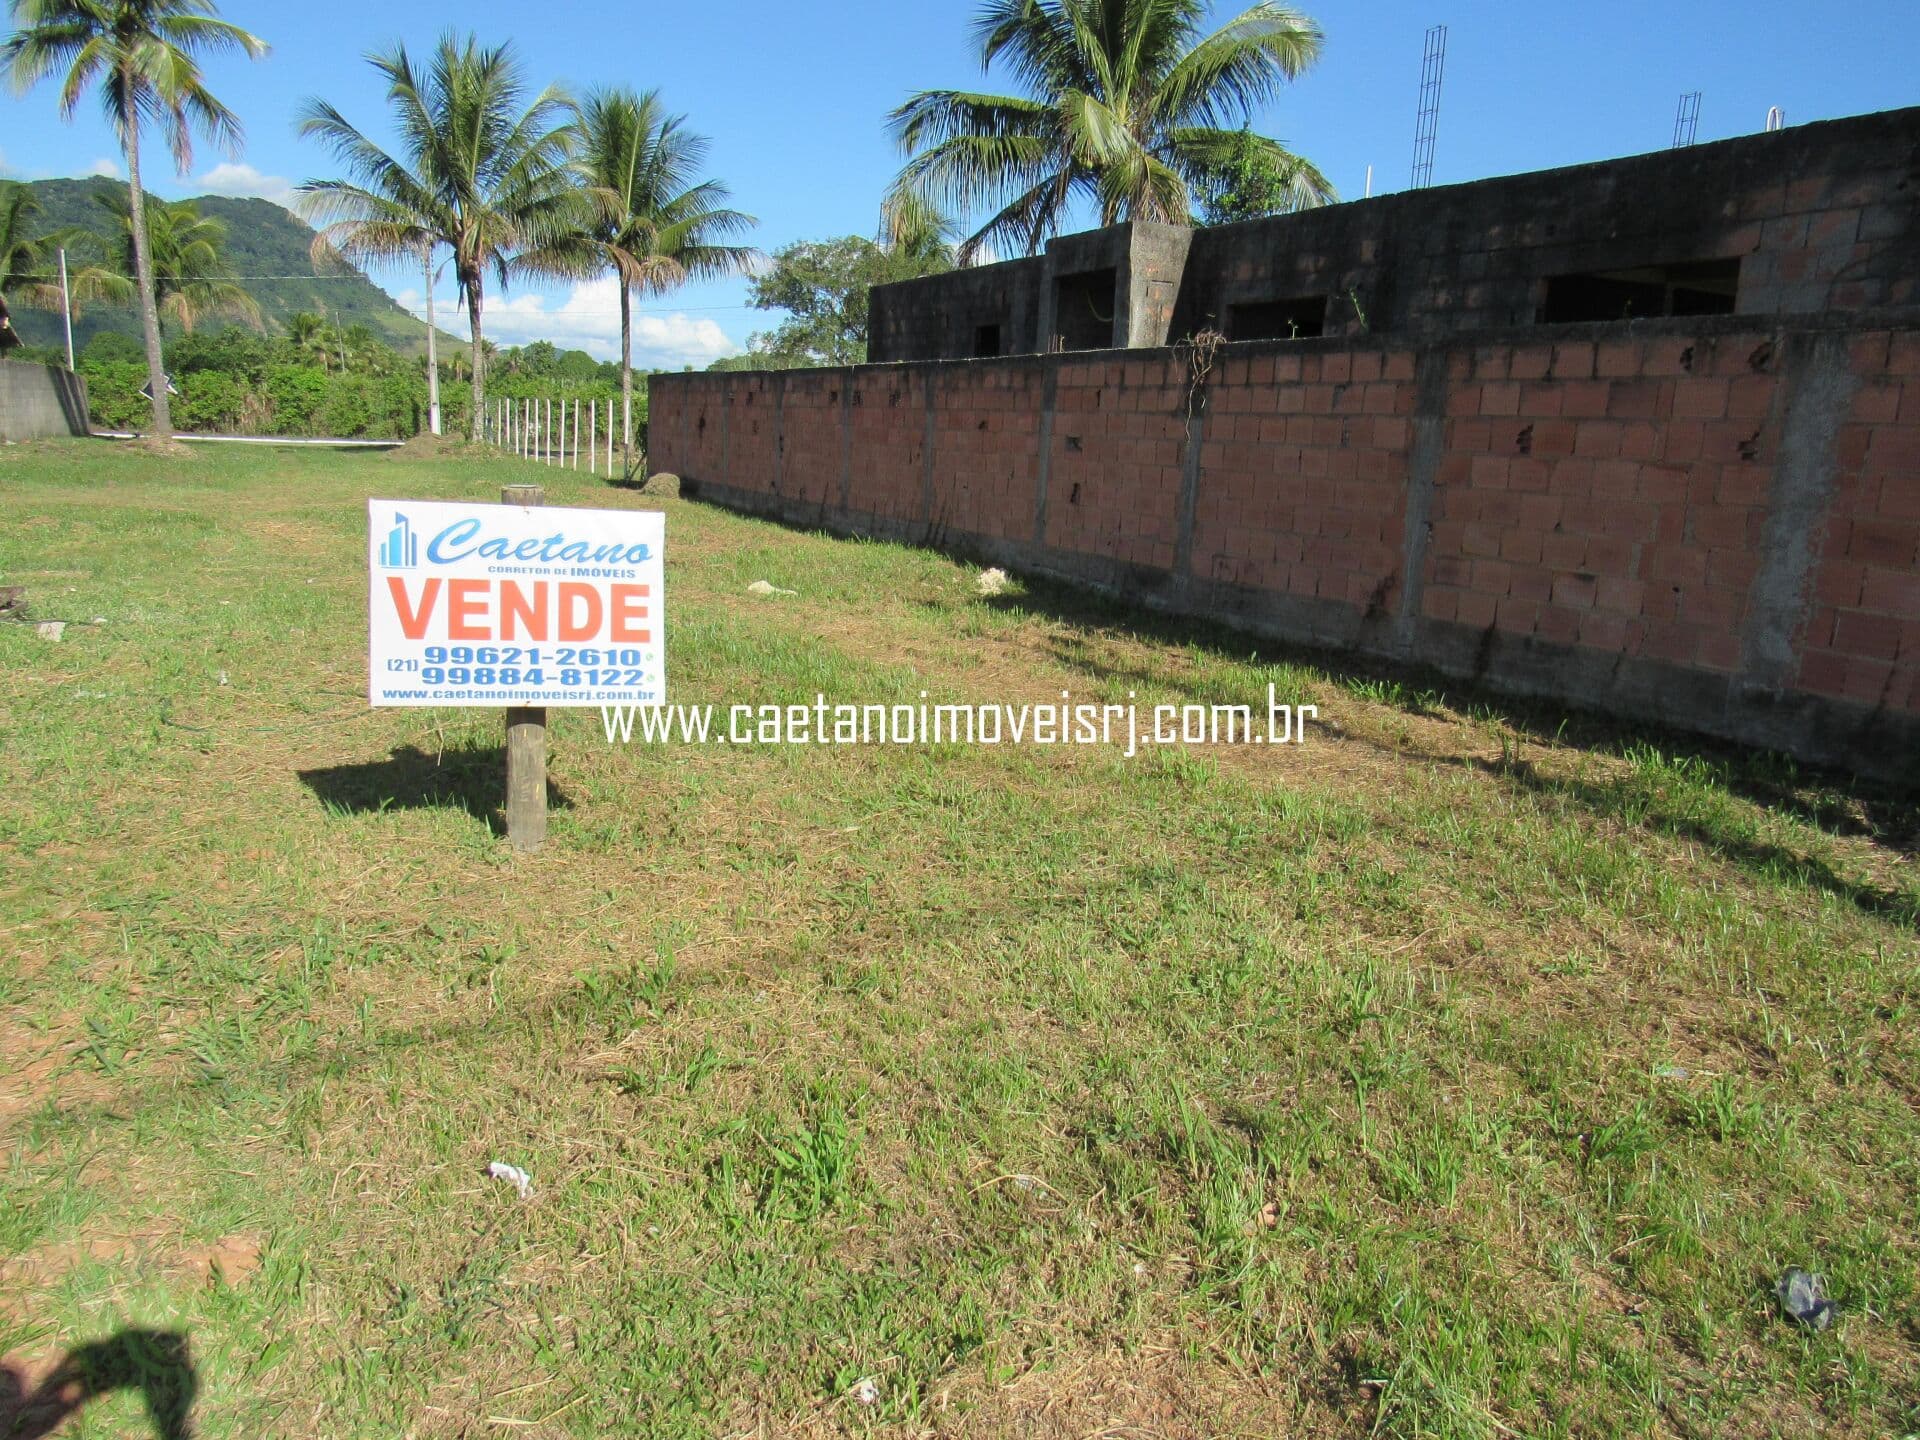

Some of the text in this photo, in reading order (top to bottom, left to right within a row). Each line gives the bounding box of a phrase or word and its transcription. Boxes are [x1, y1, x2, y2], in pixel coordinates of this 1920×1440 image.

[426, 518, 653, 565] Caetano
[487, 565, 551, 575] CORRETOR
[554, 568, 568, 576] DE
[386, 576, 651, 644] VENDE
[387, 659, 419, 672] (21)
[424, 646, 641, 667] 99621-2610
[421, 667, 644, 687] 99884-8122
[382, 688, 656, 701] www.caetanoimoveisrj.com.br
